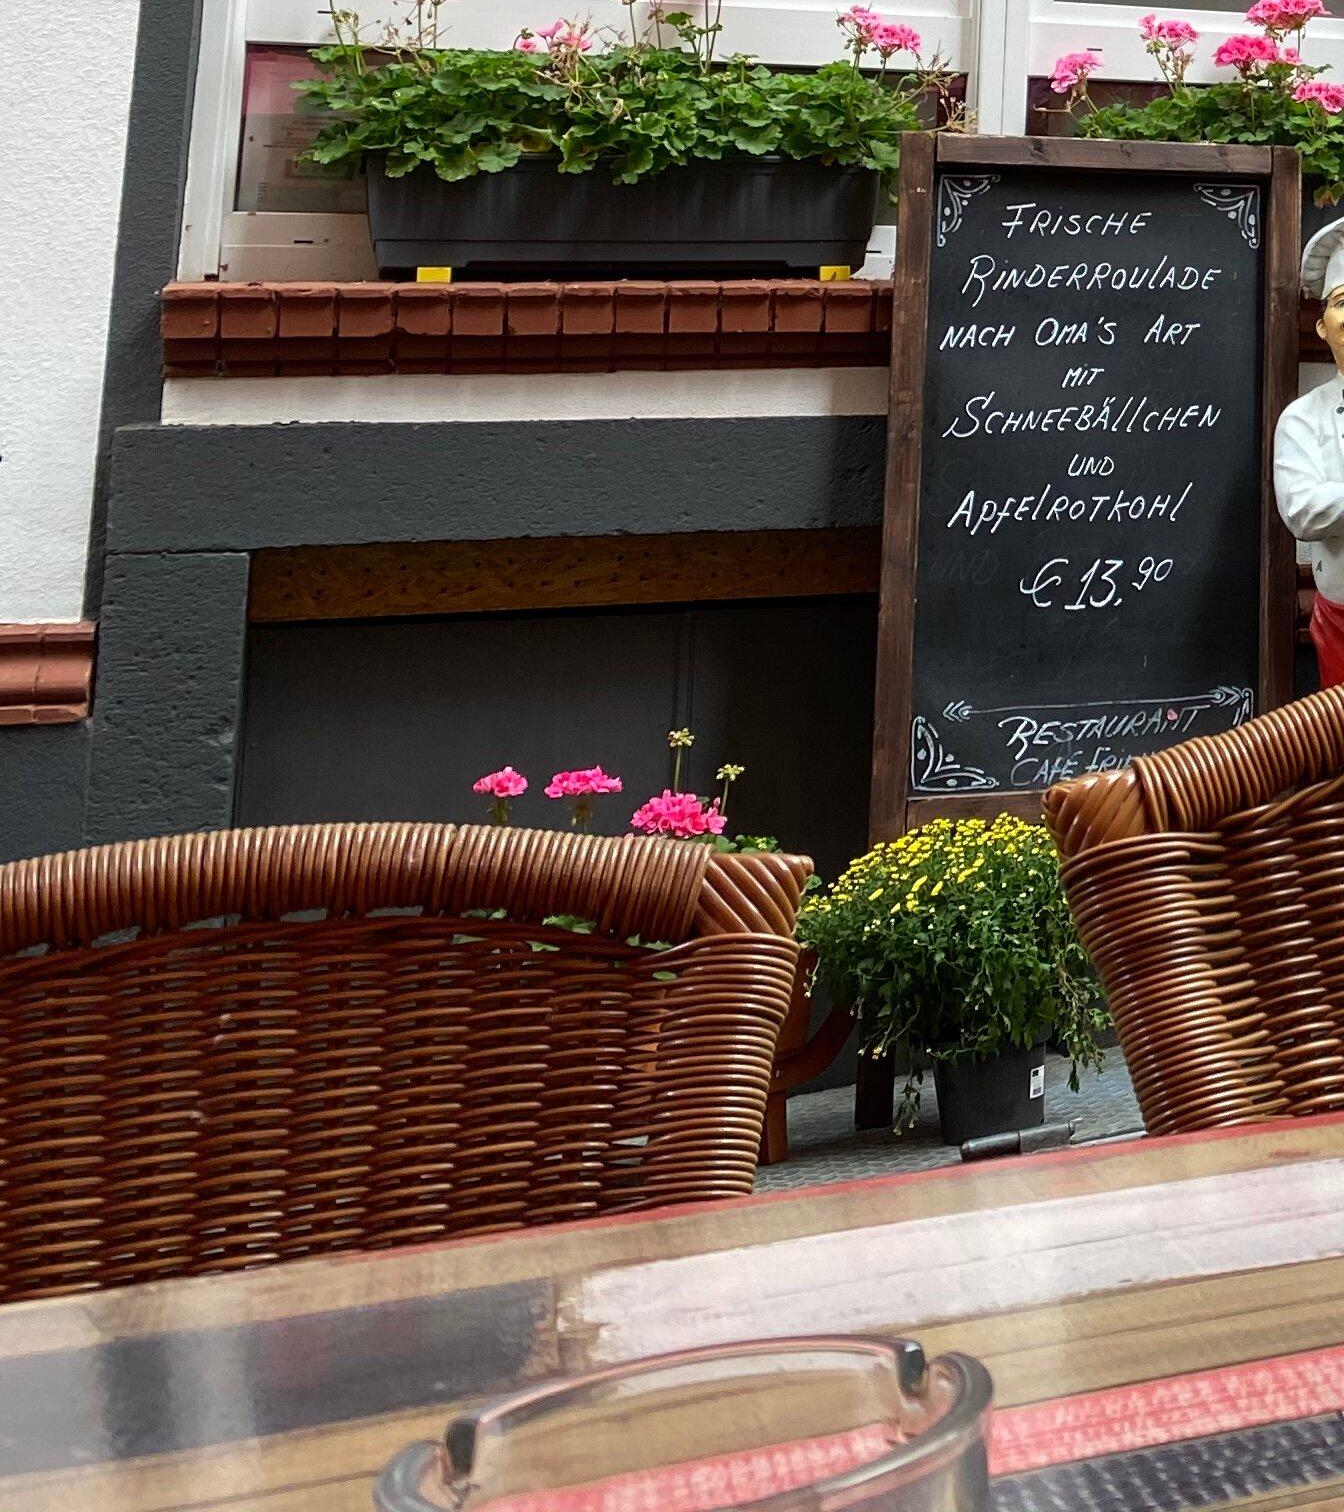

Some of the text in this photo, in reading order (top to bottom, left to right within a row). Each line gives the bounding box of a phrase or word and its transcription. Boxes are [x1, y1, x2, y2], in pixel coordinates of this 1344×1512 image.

[1001, 201, 1152, 240] FRISCHE
[961, 255, 1222, 308] RINDERROULADE
[939, 324, 1016, 352] NACH
[1143, 316, 1201, 345] ART
[1061, 365, 1105, 390] MIT
[1067, 454, 1115, 478] UND
[998, 704, 1210, 760] RESTAURANT
